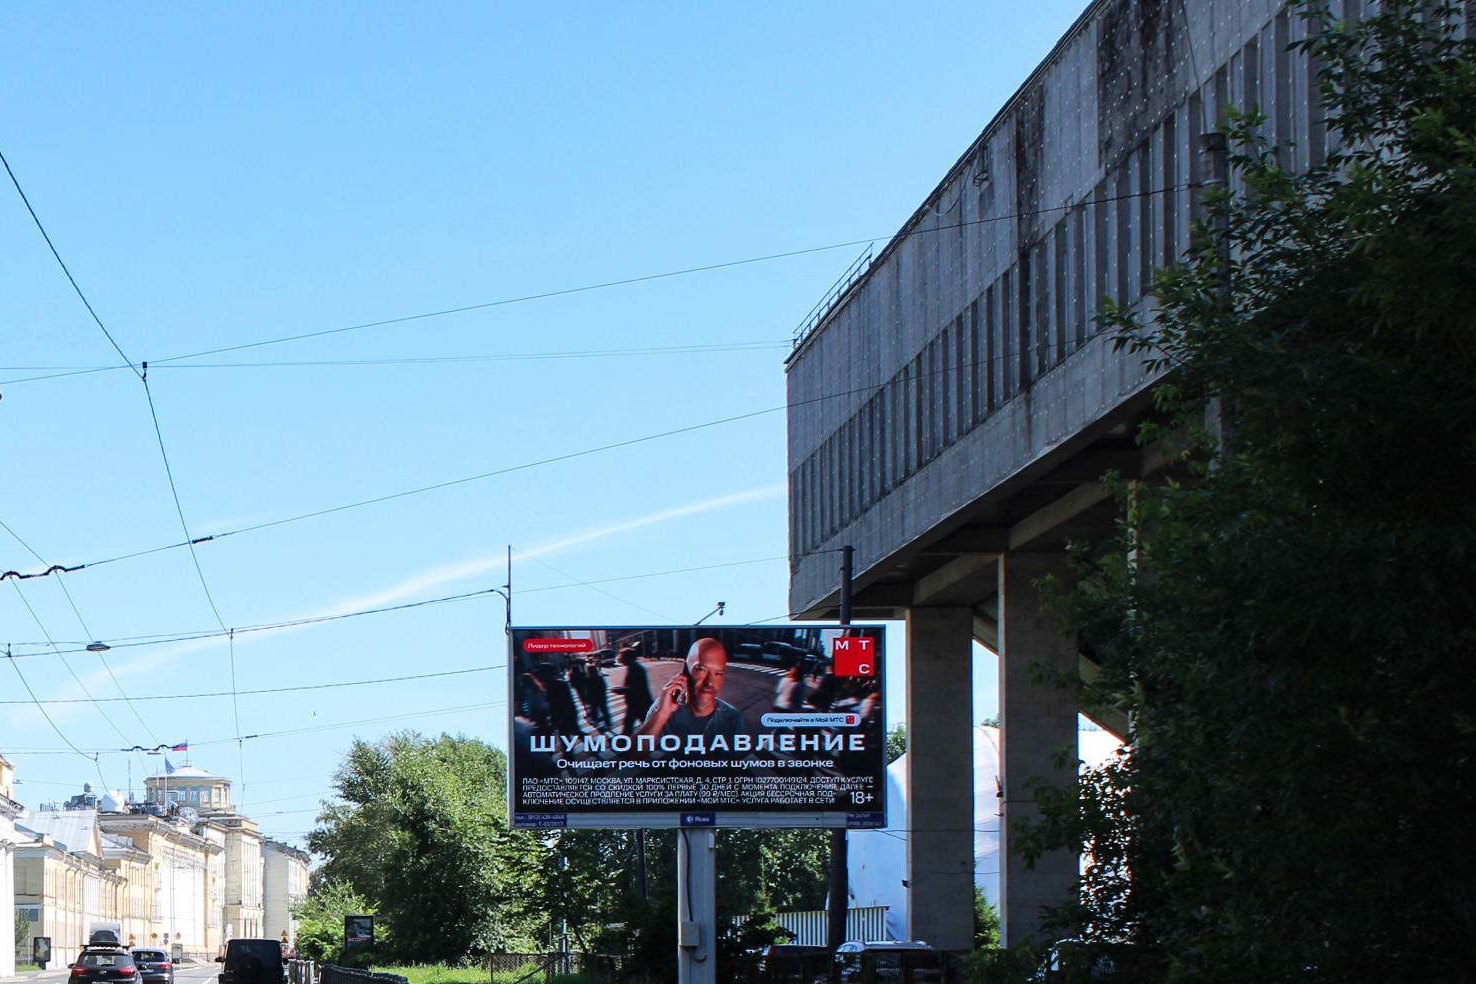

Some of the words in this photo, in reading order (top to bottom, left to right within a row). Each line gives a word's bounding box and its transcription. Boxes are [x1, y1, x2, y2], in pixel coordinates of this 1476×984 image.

[530, 734, 866, 755] ШУМОПОДАВЛЕНИЕ
[556, 759, 617, 769] Очищает
[618, 760, 650, 770] речь
[651, 760, 666, 768] от
[668, 758, 728, 770] фоновых
[730, 760, 776, 770] шумов
[777, 760, 785, 768] в
[787, 760, 834, 768] звонке
[850, 791, 874, 804] 18+
